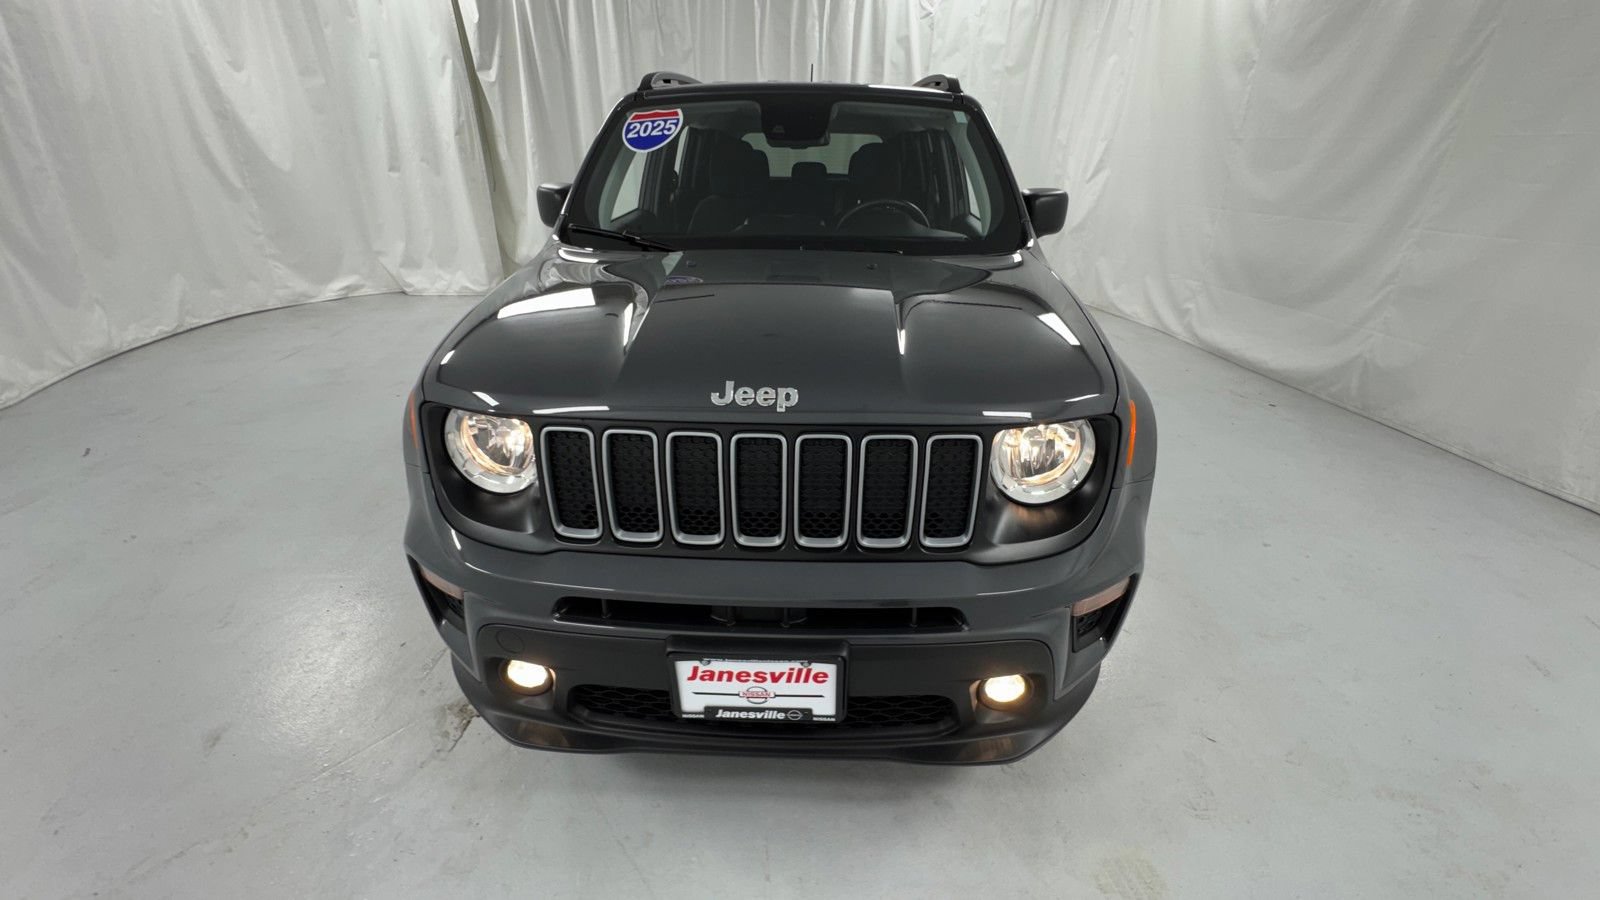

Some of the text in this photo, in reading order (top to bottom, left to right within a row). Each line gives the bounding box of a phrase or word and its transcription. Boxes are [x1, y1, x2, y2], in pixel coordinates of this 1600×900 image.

[626, 119, 678, 139] 2025
[710, 380, 799, 412] Jeep
[687, 665, 829, 684] Janesville
[715, 708, 786, 720] Janesville
